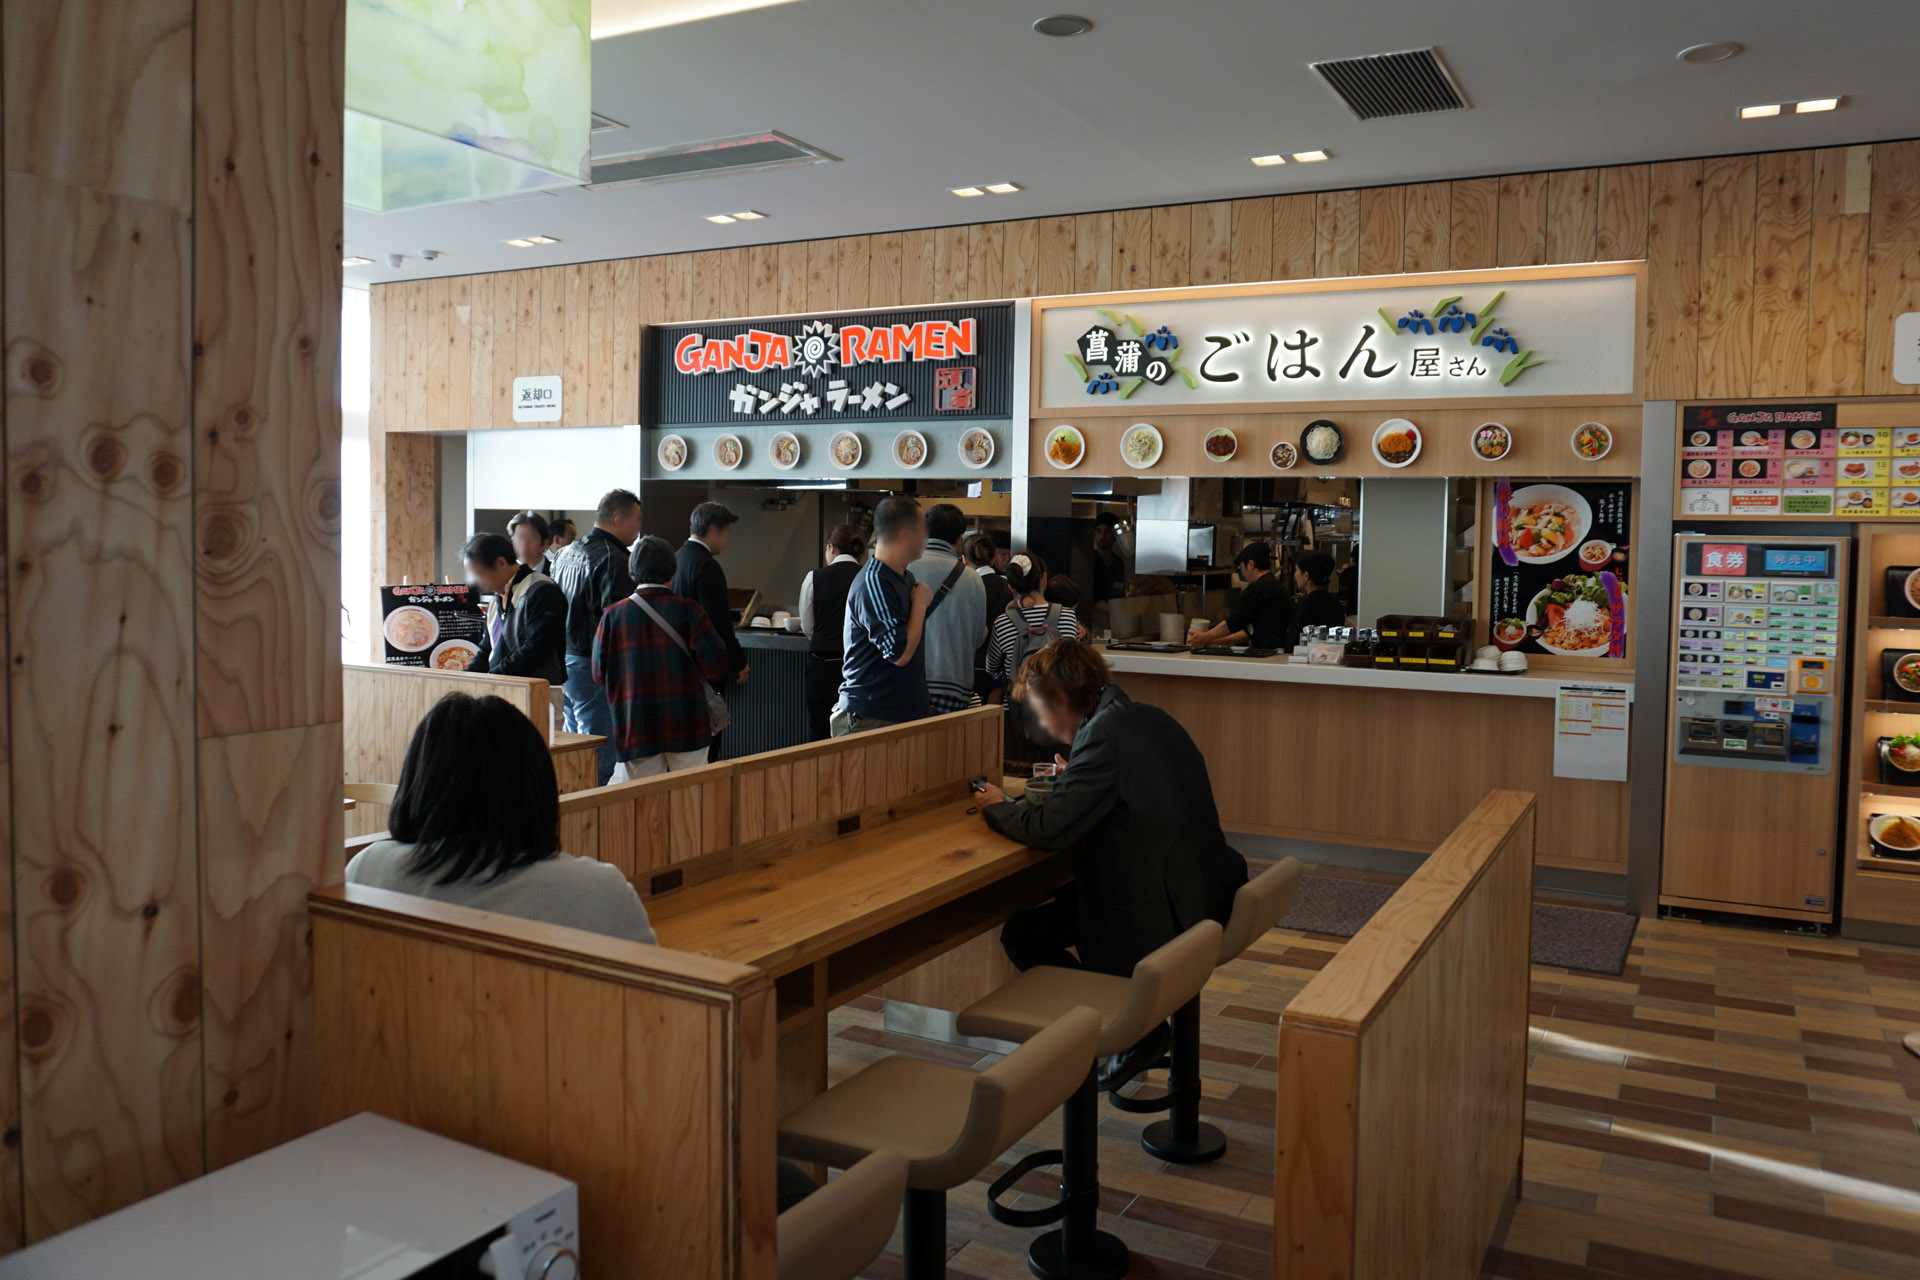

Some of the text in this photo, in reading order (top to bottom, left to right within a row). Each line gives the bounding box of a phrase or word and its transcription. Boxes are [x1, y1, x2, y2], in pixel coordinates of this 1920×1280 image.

[674, 318, 977, 375] GANJA RAMEN
[1086, 329, 1167, 381] 菖蒲の
[521, 388, 552, 402] 返却口
[729, 379, 912, 415] ガンジャ ラーメン
[1727, 411, 1774, 423] GANJA
[1775, 411, 1822, 422] RAMEN
[1705, 551, 1744, 568] 食券
[392, 585, 469, 596] GANJA RAMEN
